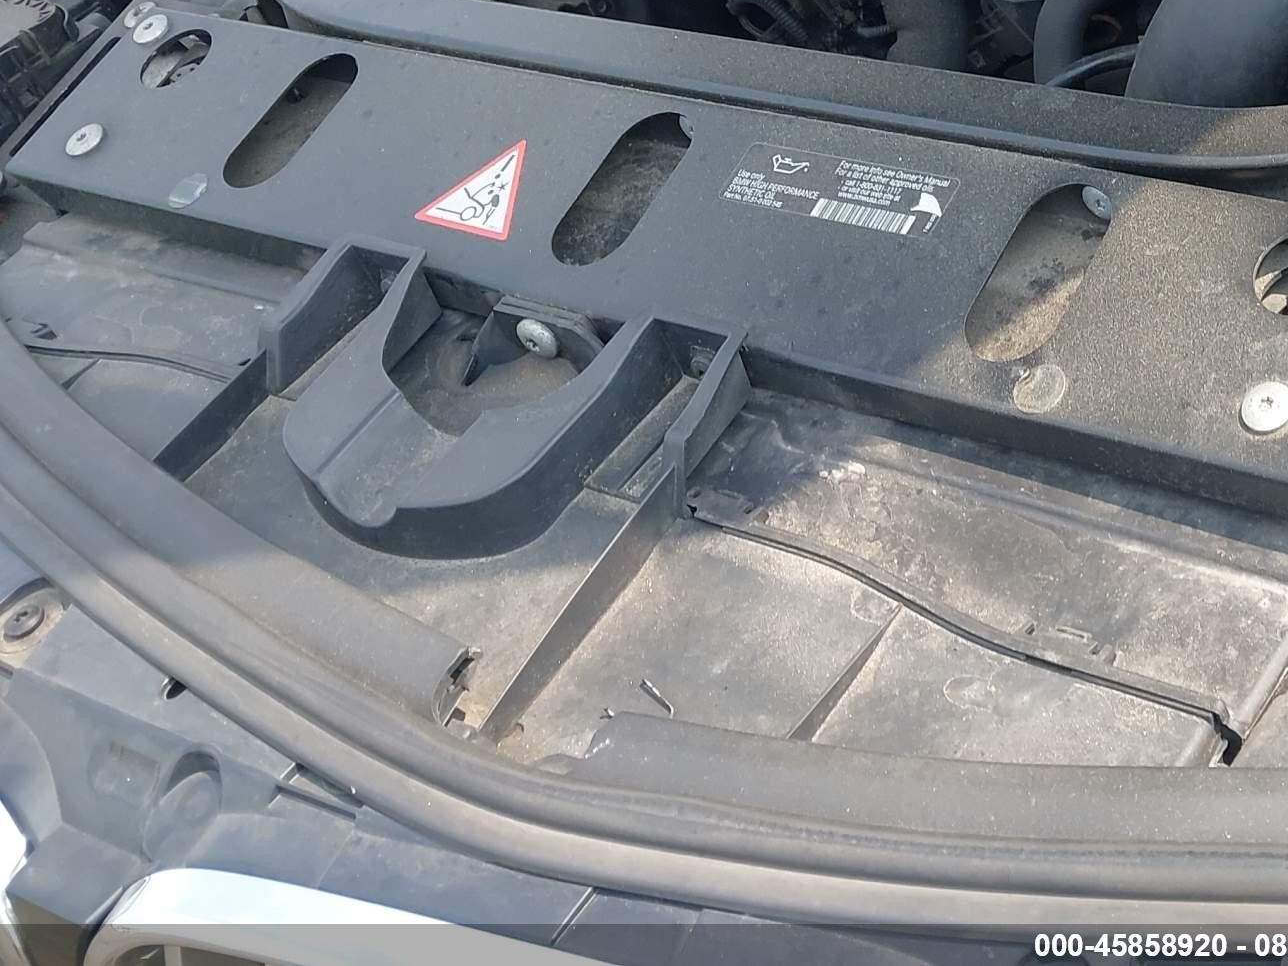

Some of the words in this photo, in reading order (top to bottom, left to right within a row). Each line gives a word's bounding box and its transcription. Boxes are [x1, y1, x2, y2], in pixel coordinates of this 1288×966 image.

[738, 169, 750, 179] Use
[834, 166, 847, 176] For
[889, 177, 922, 191] approved
[840, 160, 851, 169] For
[851, 163, 869, 173] more
[895, 170, 923, 183] Owner's
[923, 175, 951, 187] Manual
[727, 183, 765, 198] SYNTHETIC
[764, 190, 776, 200] OIL
[732, 176, 751, 187] BMW
[750, 179, 769, 190] HIGH
[767, 183, 819, 200] PERFORMANCE
